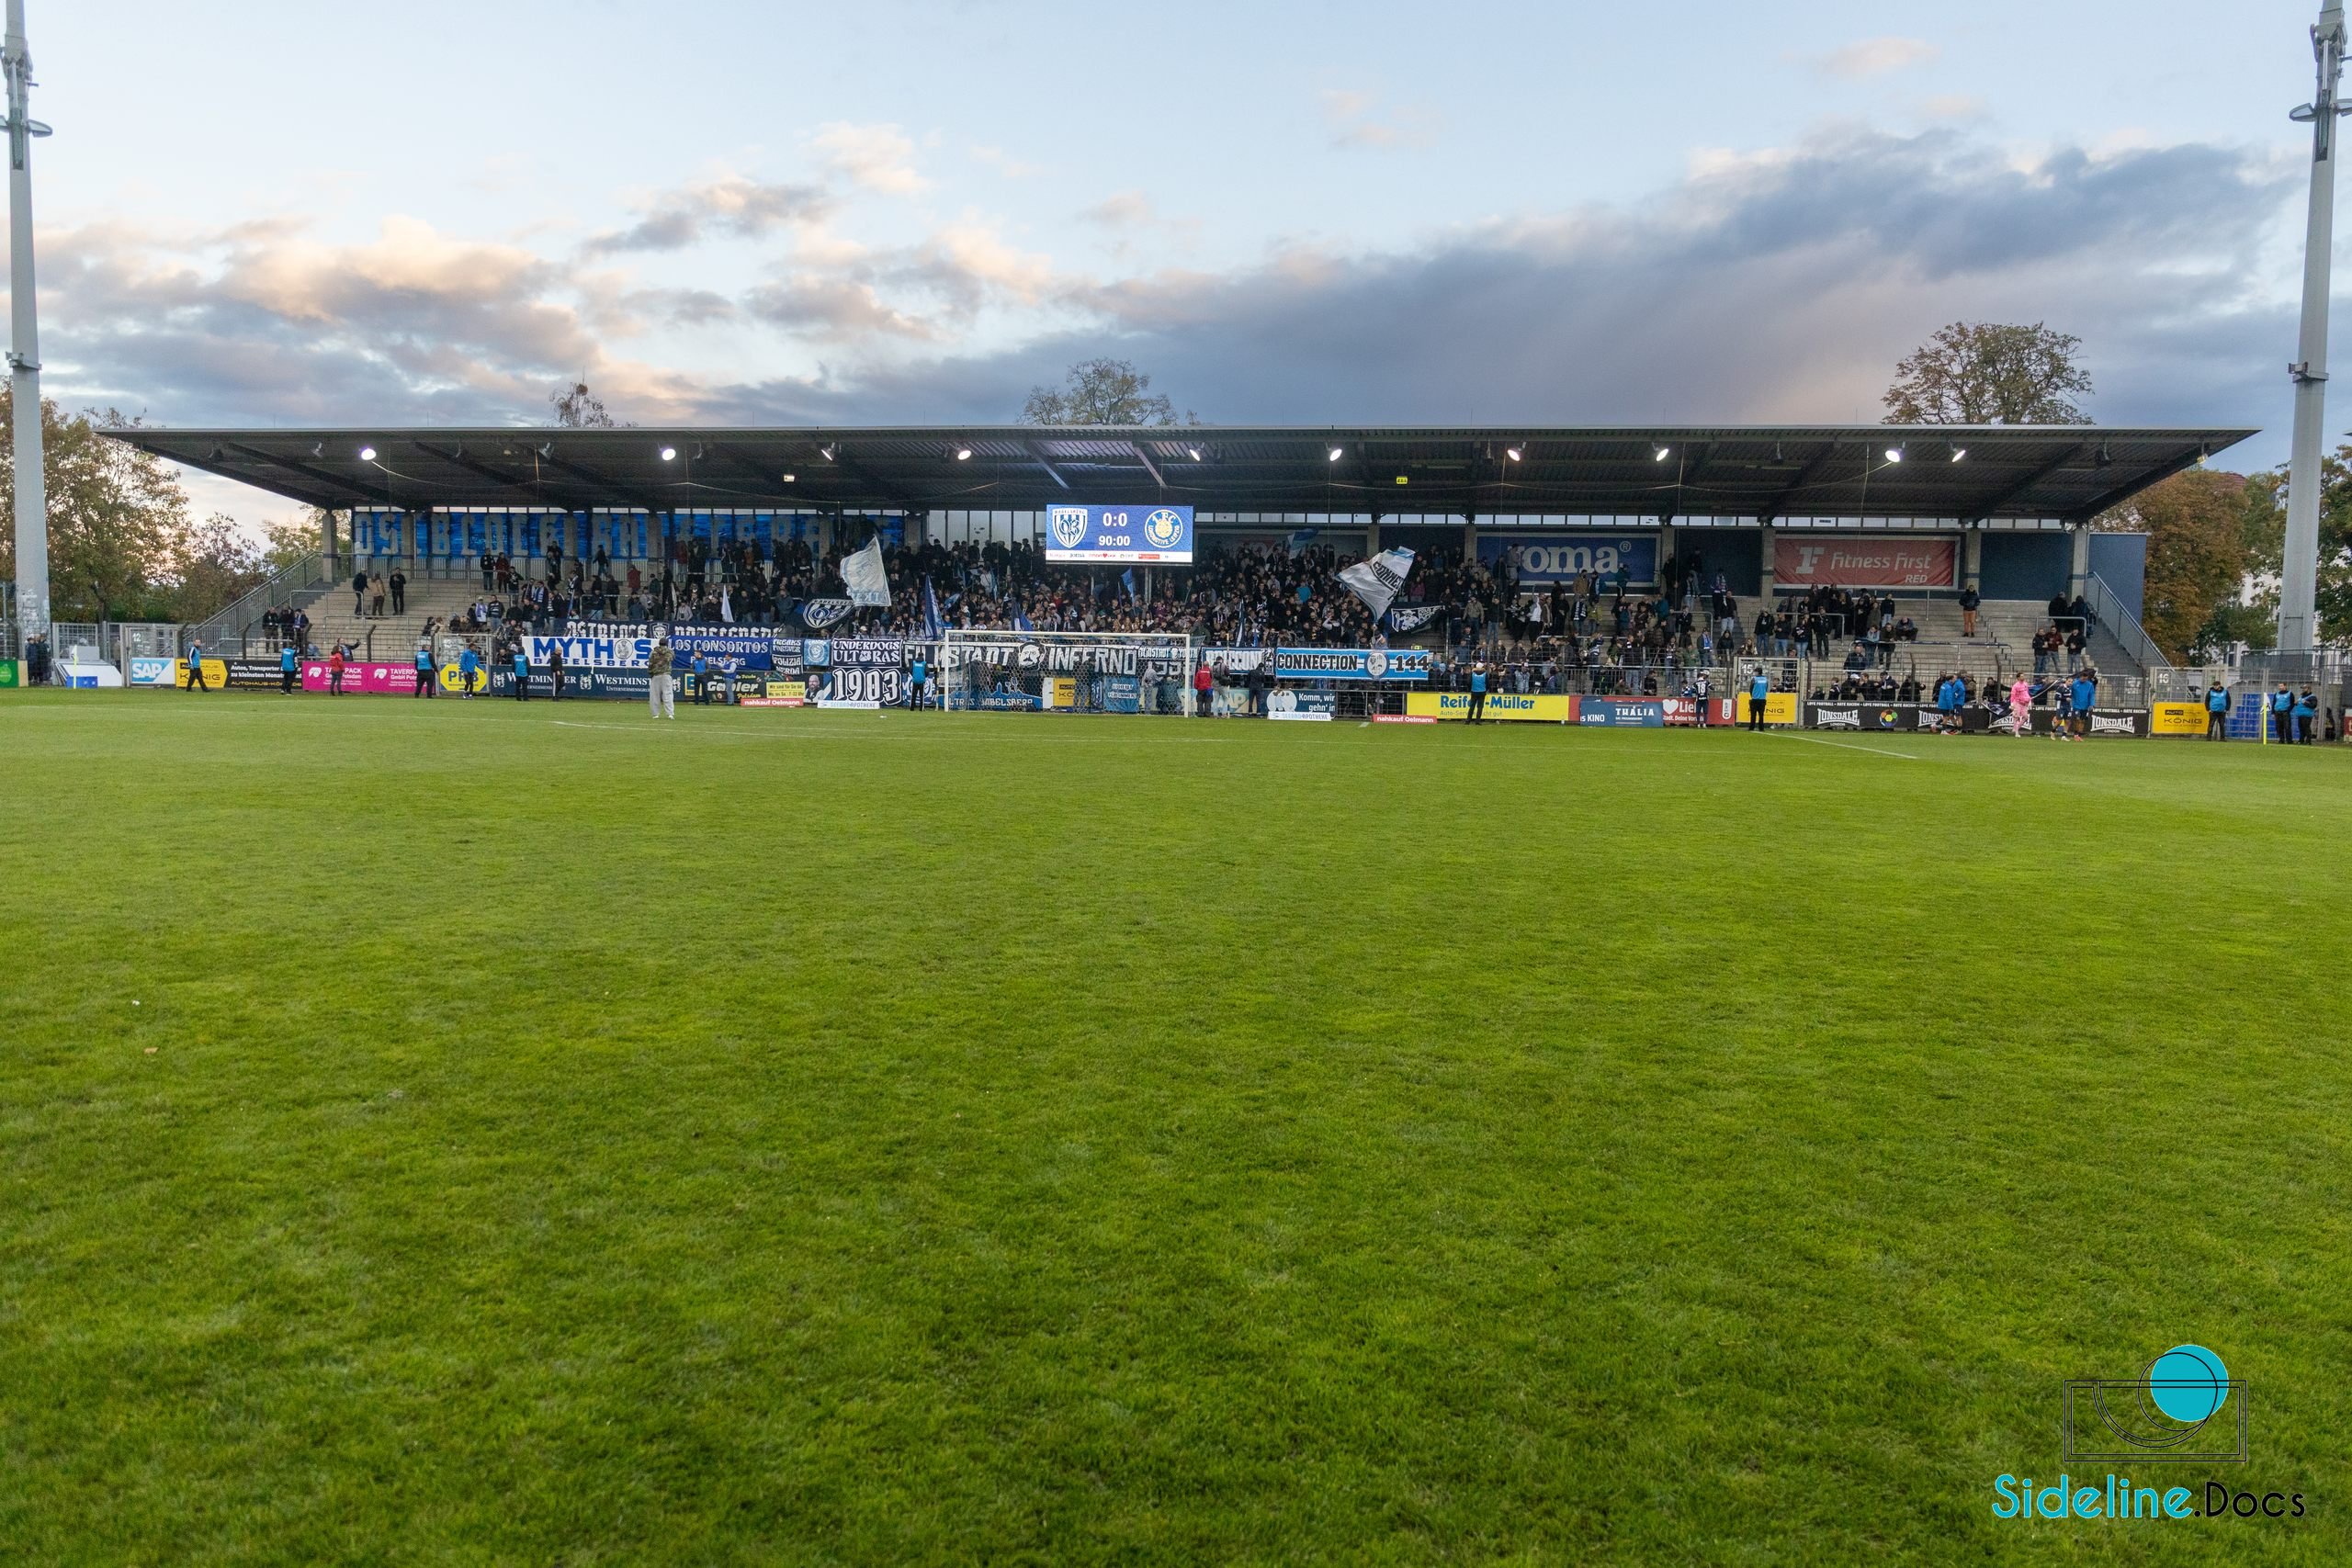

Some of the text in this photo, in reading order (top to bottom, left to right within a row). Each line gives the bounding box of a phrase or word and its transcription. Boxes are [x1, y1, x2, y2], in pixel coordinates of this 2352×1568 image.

[1102, 513, 1127, 526] 0:0
[1099, 536, 1130, 547] 90:00
[1905, 574, 1928, 582] RED
[668, 638, 769, 654] LOS CONSORTOS
[832, 640, 900, 650] UNDERDOGS
[1048, 647, 1137, 675] INFERNO
[1277, 653, 1358, 671] CONNECTION
[132, 662, 163, 678] SAP
[1741, 663, 1753, 674] 15
[594, 673, 650, 686] WESTMINST
[832, 668, 901, 705] 1903
[1698, 683, 1706, 694] 18
[1298, 693, 1335, 703] Komm, wir
[1440, 694, 1535, 709] Reife-Müller
[1587, 714, 1604, 722] KINO
[1817, 708, 1860, 726] LONSDALE
[2091, 715, 2134, 733] LONSDALE
